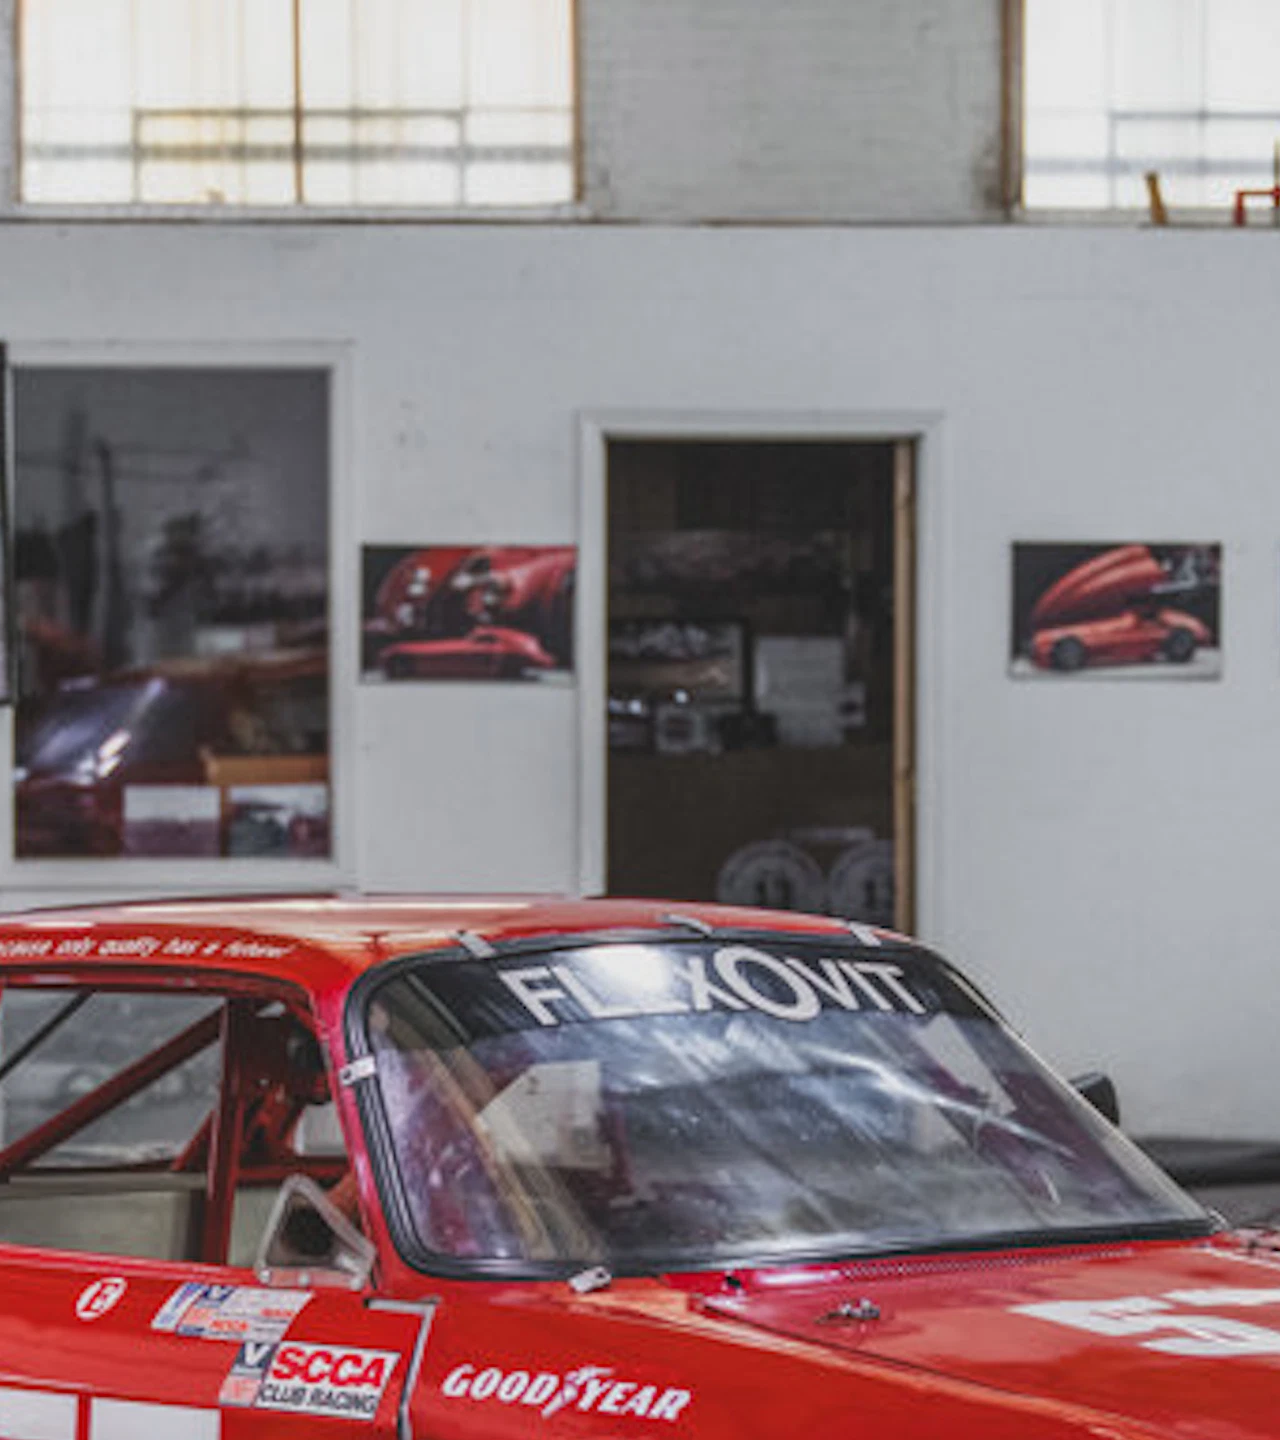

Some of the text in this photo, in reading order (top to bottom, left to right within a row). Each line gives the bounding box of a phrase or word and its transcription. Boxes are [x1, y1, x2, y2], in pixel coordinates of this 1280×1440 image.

[272, 1346, 386, 1388] SCCA
[257, 1383, 307, 1405] CLUB
[307, 1386, 379, 1414] RACING
